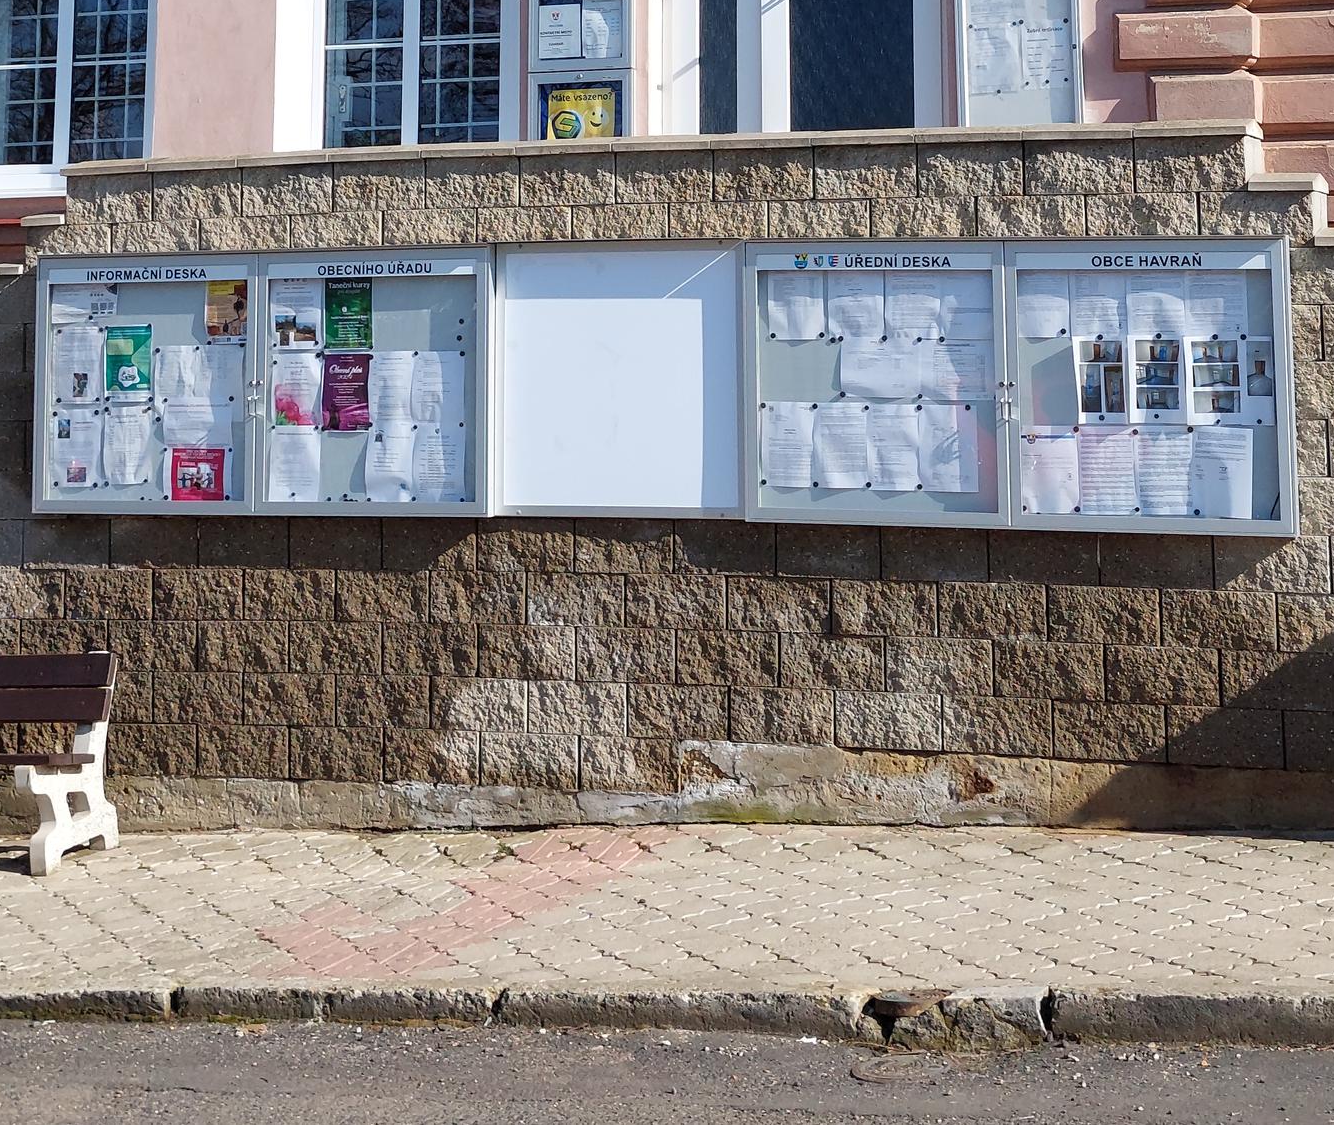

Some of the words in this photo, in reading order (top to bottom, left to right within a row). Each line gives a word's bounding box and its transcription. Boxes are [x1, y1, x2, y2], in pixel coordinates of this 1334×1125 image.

[551, 94, 571, 102] Máte
[573, 92, 613, 101] vsazeno?
[844, 254, 898, 268] ÚŘEDNÍ
[902, 256, 951, 267] DESKA
[1091, 256, 1134, 267] OBCE
[1138, 252, 1202, 267] HAVRAŇ
[87, 267, 162, 281] INFORMAČNÍ
[165, 268, 207, 279] DESKA
[317, 261, 384, 275] OBECNÍHO
[387, 261, 432, 274] ÚŘADU
